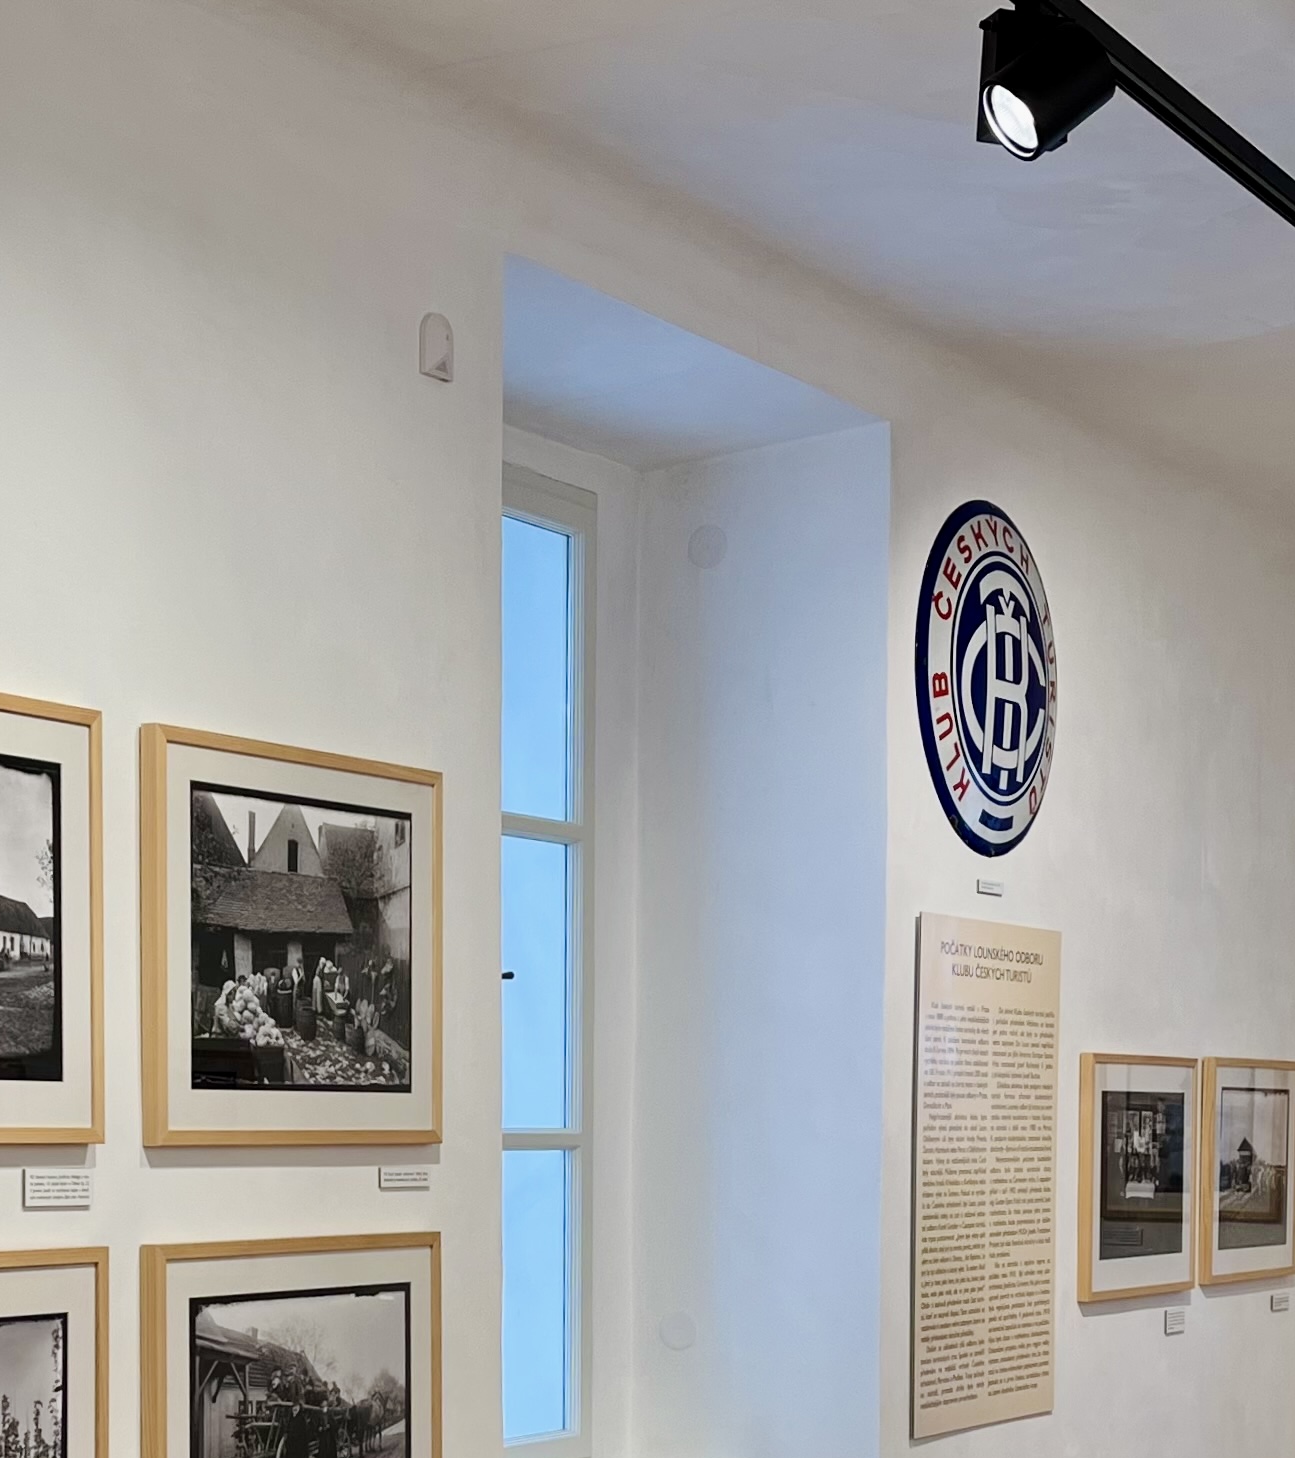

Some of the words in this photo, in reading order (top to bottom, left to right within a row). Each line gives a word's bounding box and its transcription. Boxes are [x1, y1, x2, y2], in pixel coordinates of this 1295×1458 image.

[932, 515, 1032, 621] ČESKÝCH
[932, 670, 971, 802] KLUB
[951, 963, 974, 978] KLUBU
[1015, 950, 1044, 966] ODBORU
